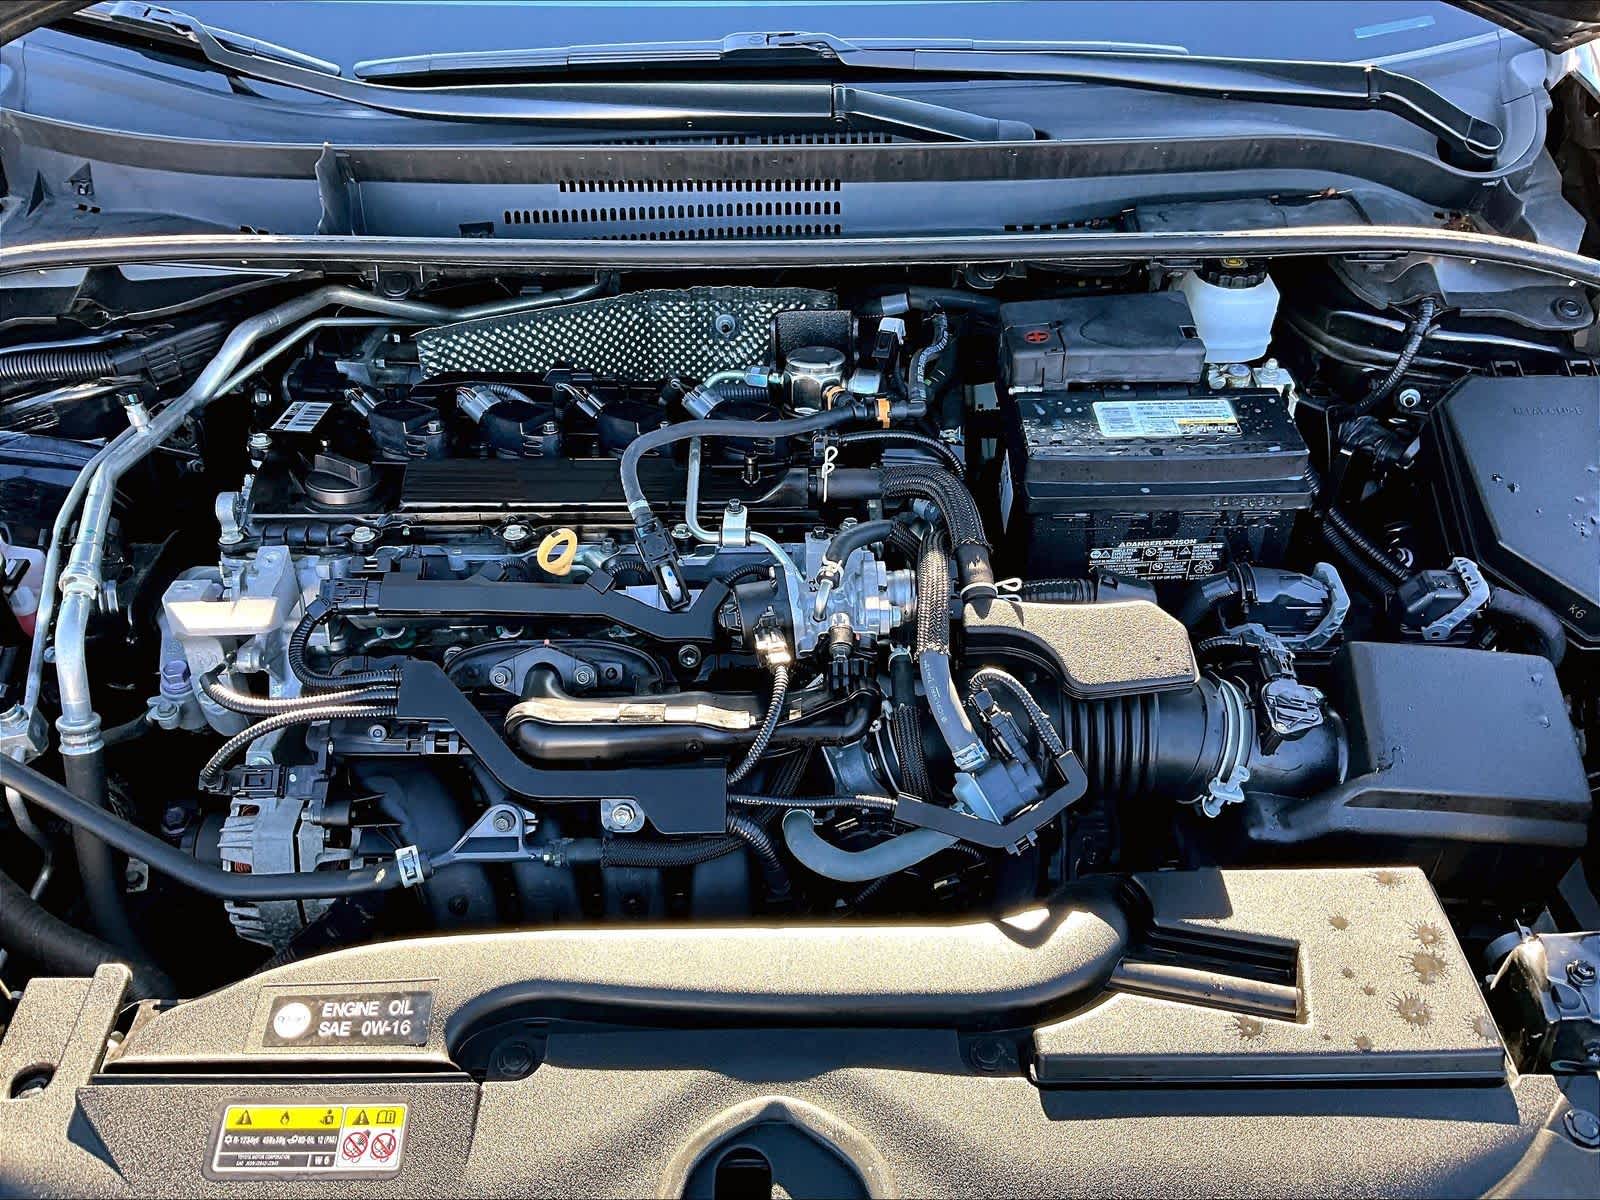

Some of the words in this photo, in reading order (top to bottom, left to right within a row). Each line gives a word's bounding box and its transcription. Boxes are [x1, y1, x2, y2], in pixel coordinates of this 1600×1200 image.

[322, 1001, 379, 1017] ENGINE
[388, 1000, 414, 1015] OIL
[318, 1020, 352, 1037] SAE
[361, 1020, 411, 1036] 0W-16
